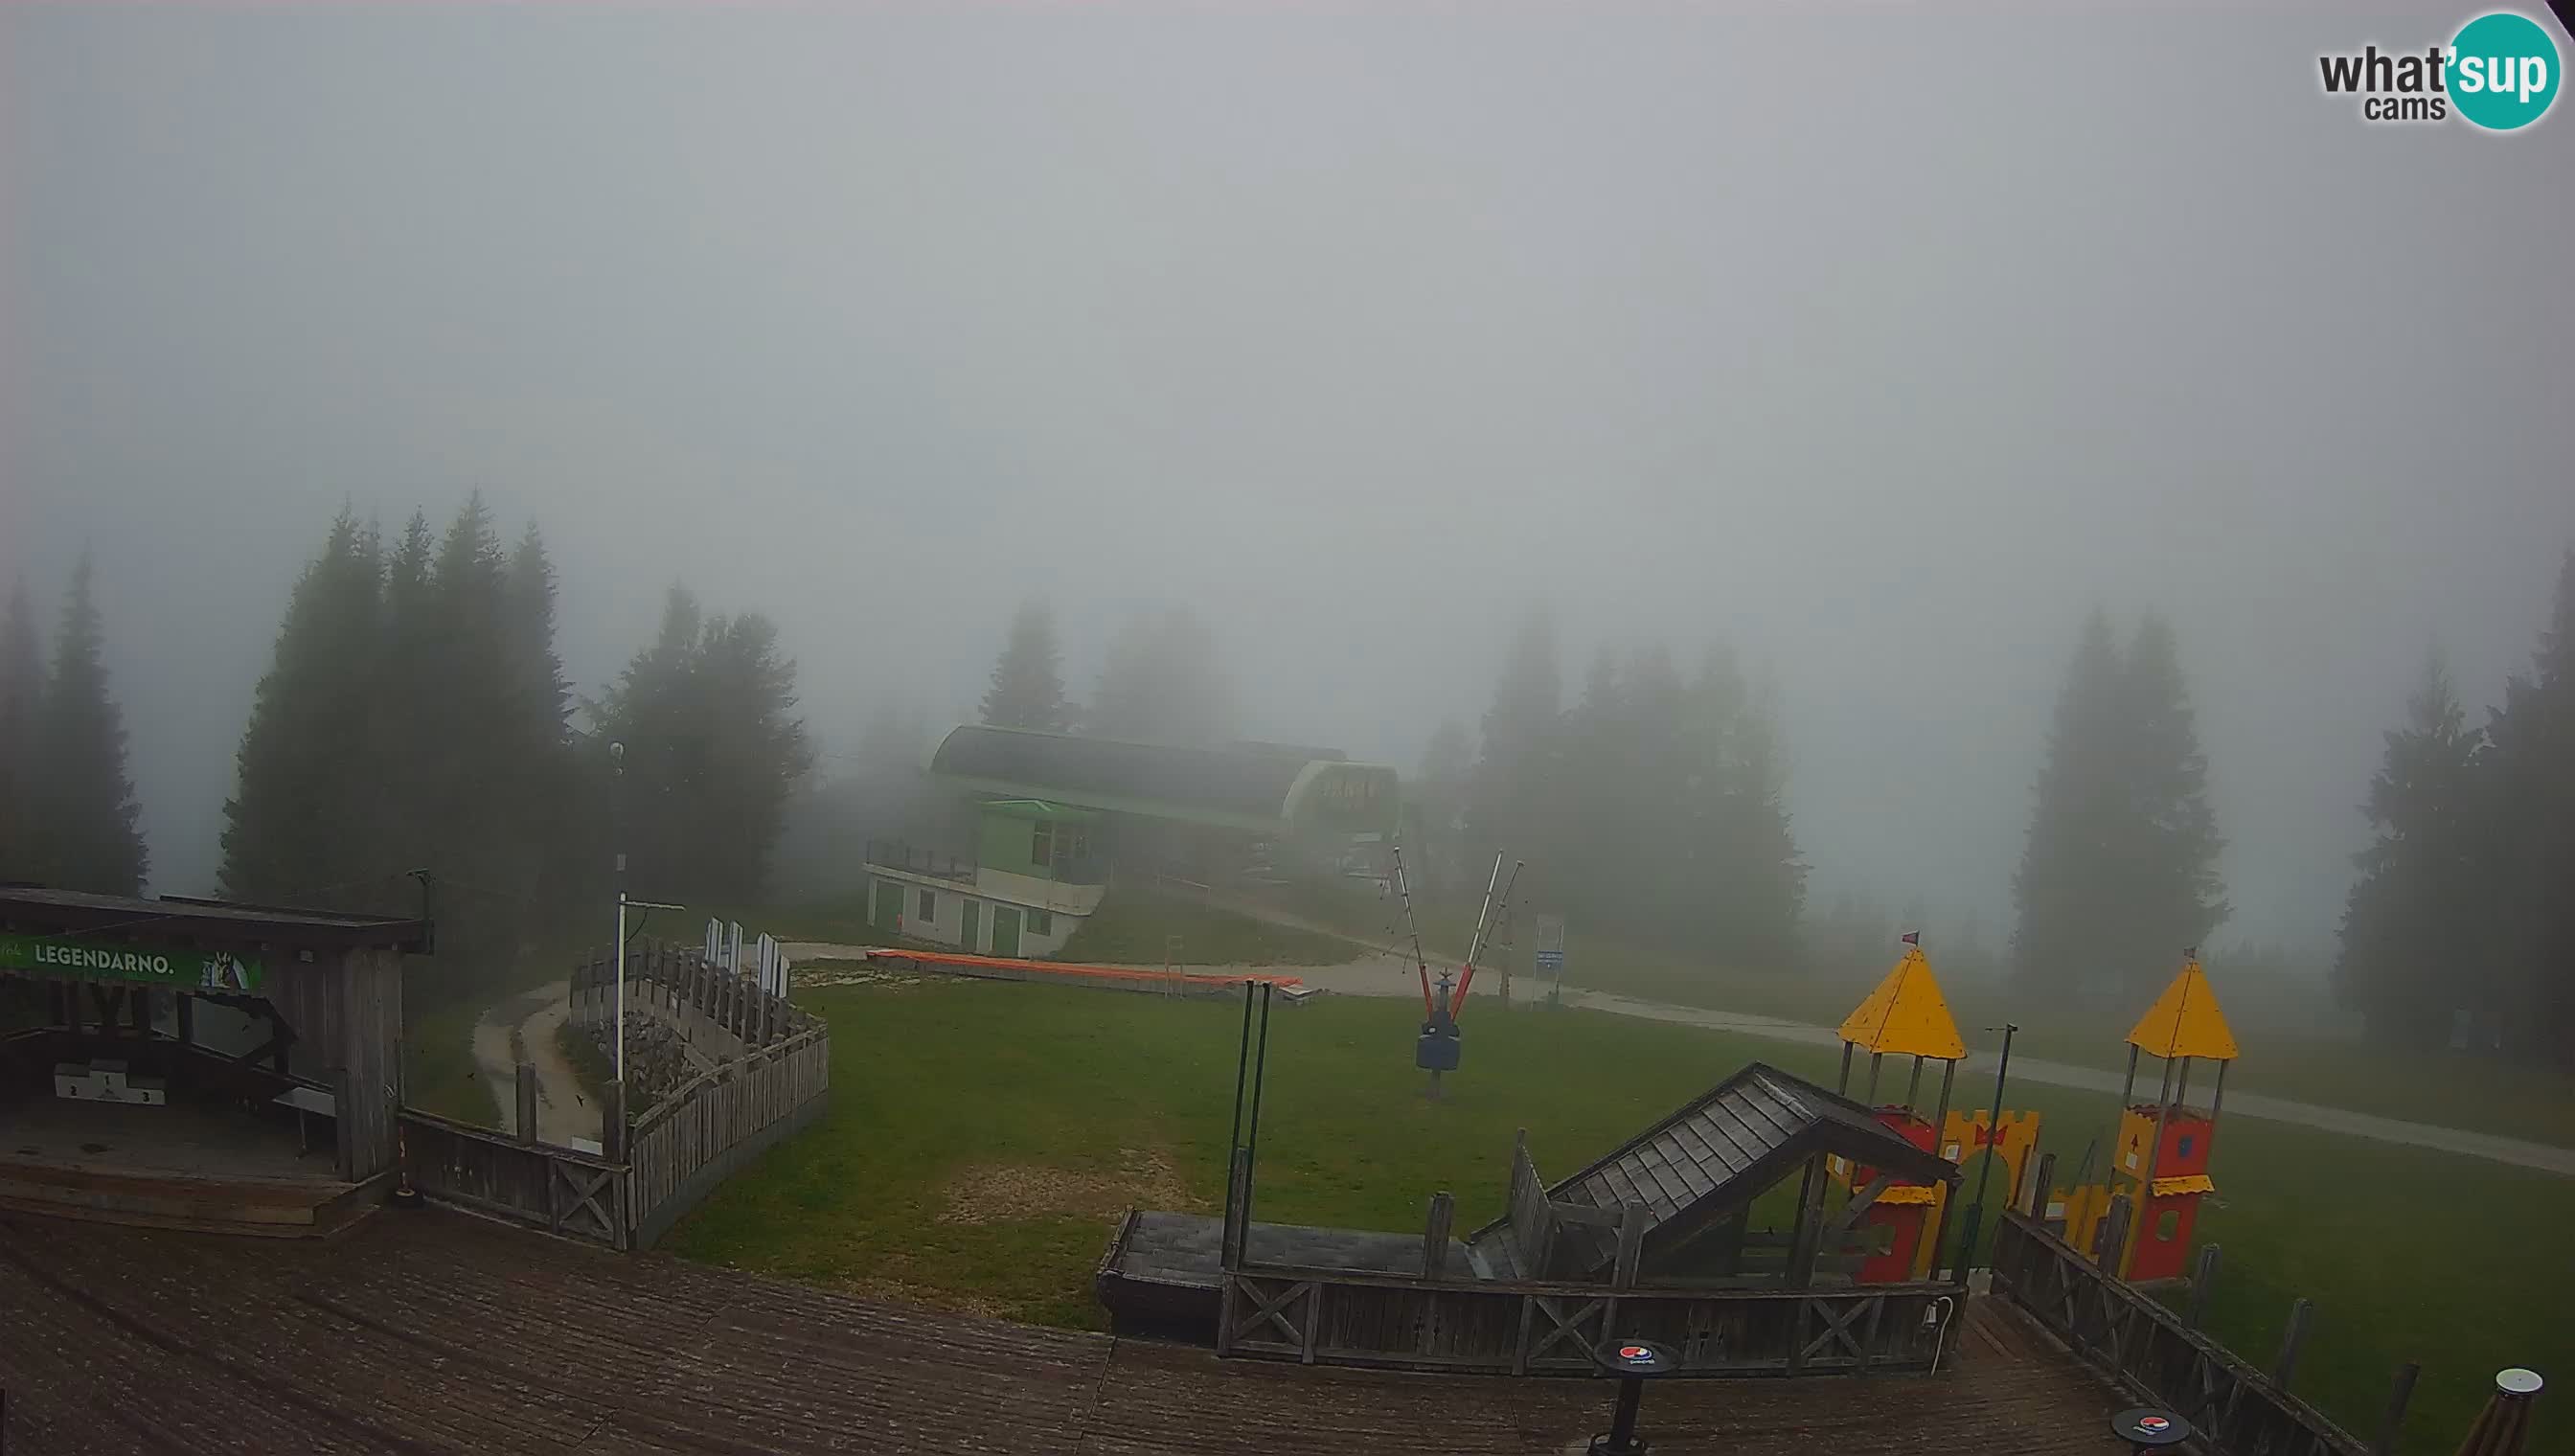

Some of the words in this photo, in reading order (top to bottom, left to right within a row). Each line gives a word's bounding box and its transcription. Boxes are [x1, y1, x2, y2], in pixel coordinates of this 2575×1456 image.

[34, 944, 175, 975] LEGENDARNO.
[70, 1084, 78, 1097] 2
[142, 1091, 150, 1103] 3
